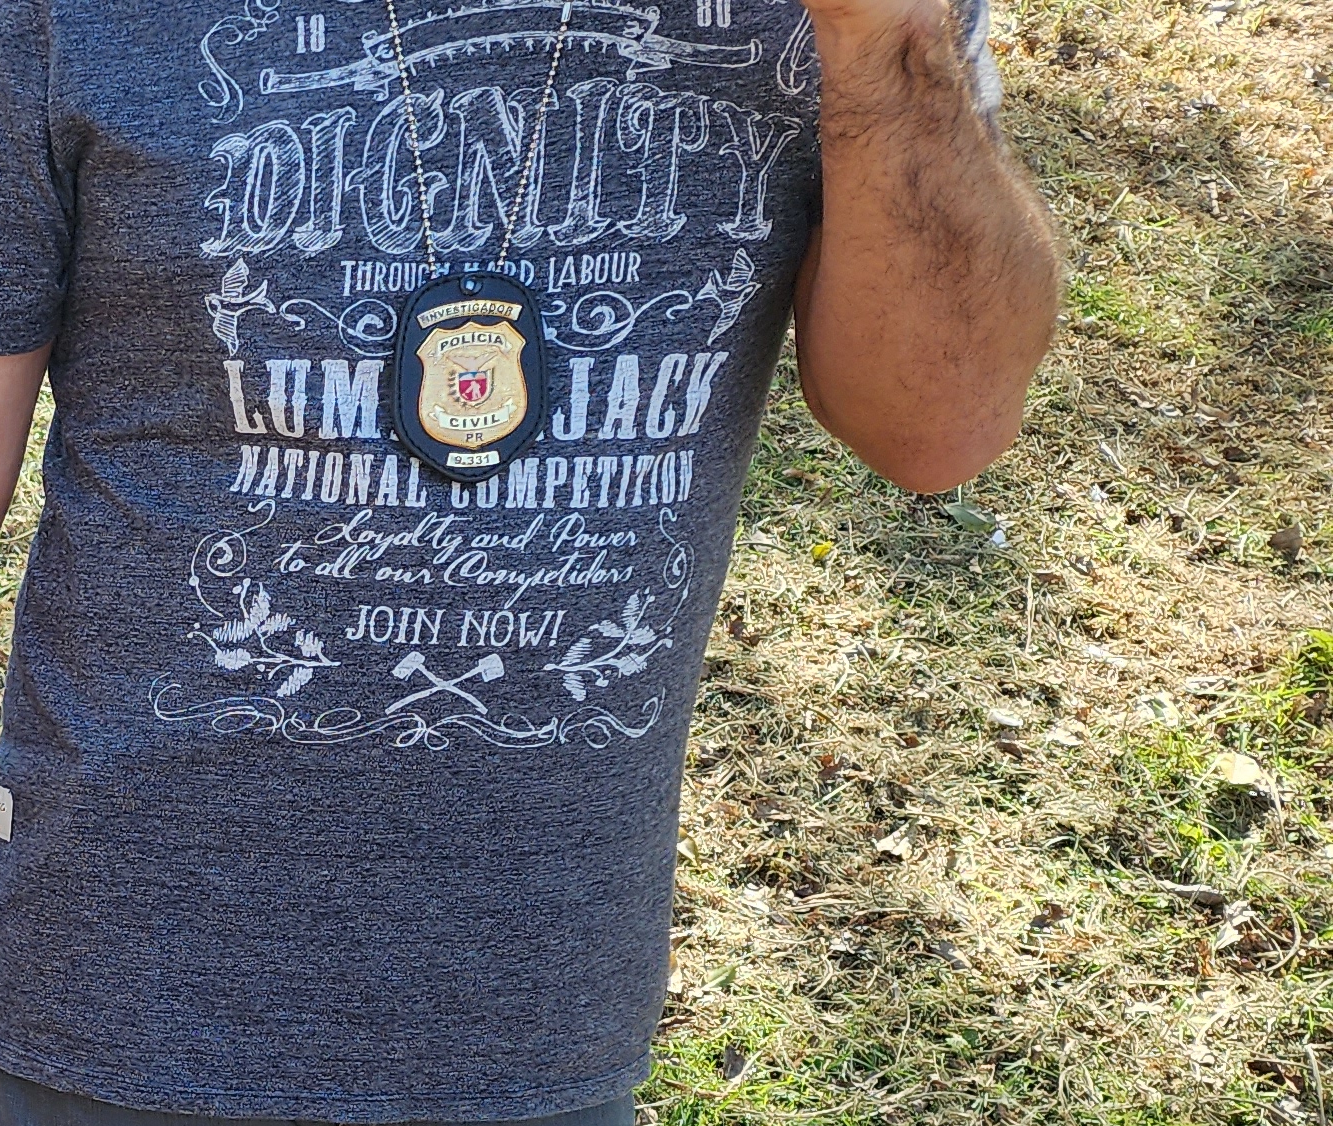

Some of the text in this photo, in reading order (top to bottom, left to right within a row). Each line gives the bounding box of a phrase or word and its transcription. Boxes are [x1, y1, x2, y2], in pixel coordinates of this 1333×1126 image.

[295, 15, 326, 54] 18
[199, 78, 804, 260] DIGNITY
[547, 252, 641, 293] LABOUR
[449, 413, 500, 428] CIVIL
[466, 432, 483, 442] PR
[229, 444, 427, 508] NATIONAL
[454, 454, 490, 465] 9.331
[315, 508, 638, 563] Loyalty and Power
[273, 543, 316, 574] to
[315, 546, 373, 579] all
[375, 569, 435, 586] our
[345, 605, 568, 648] JOIN NOW!
